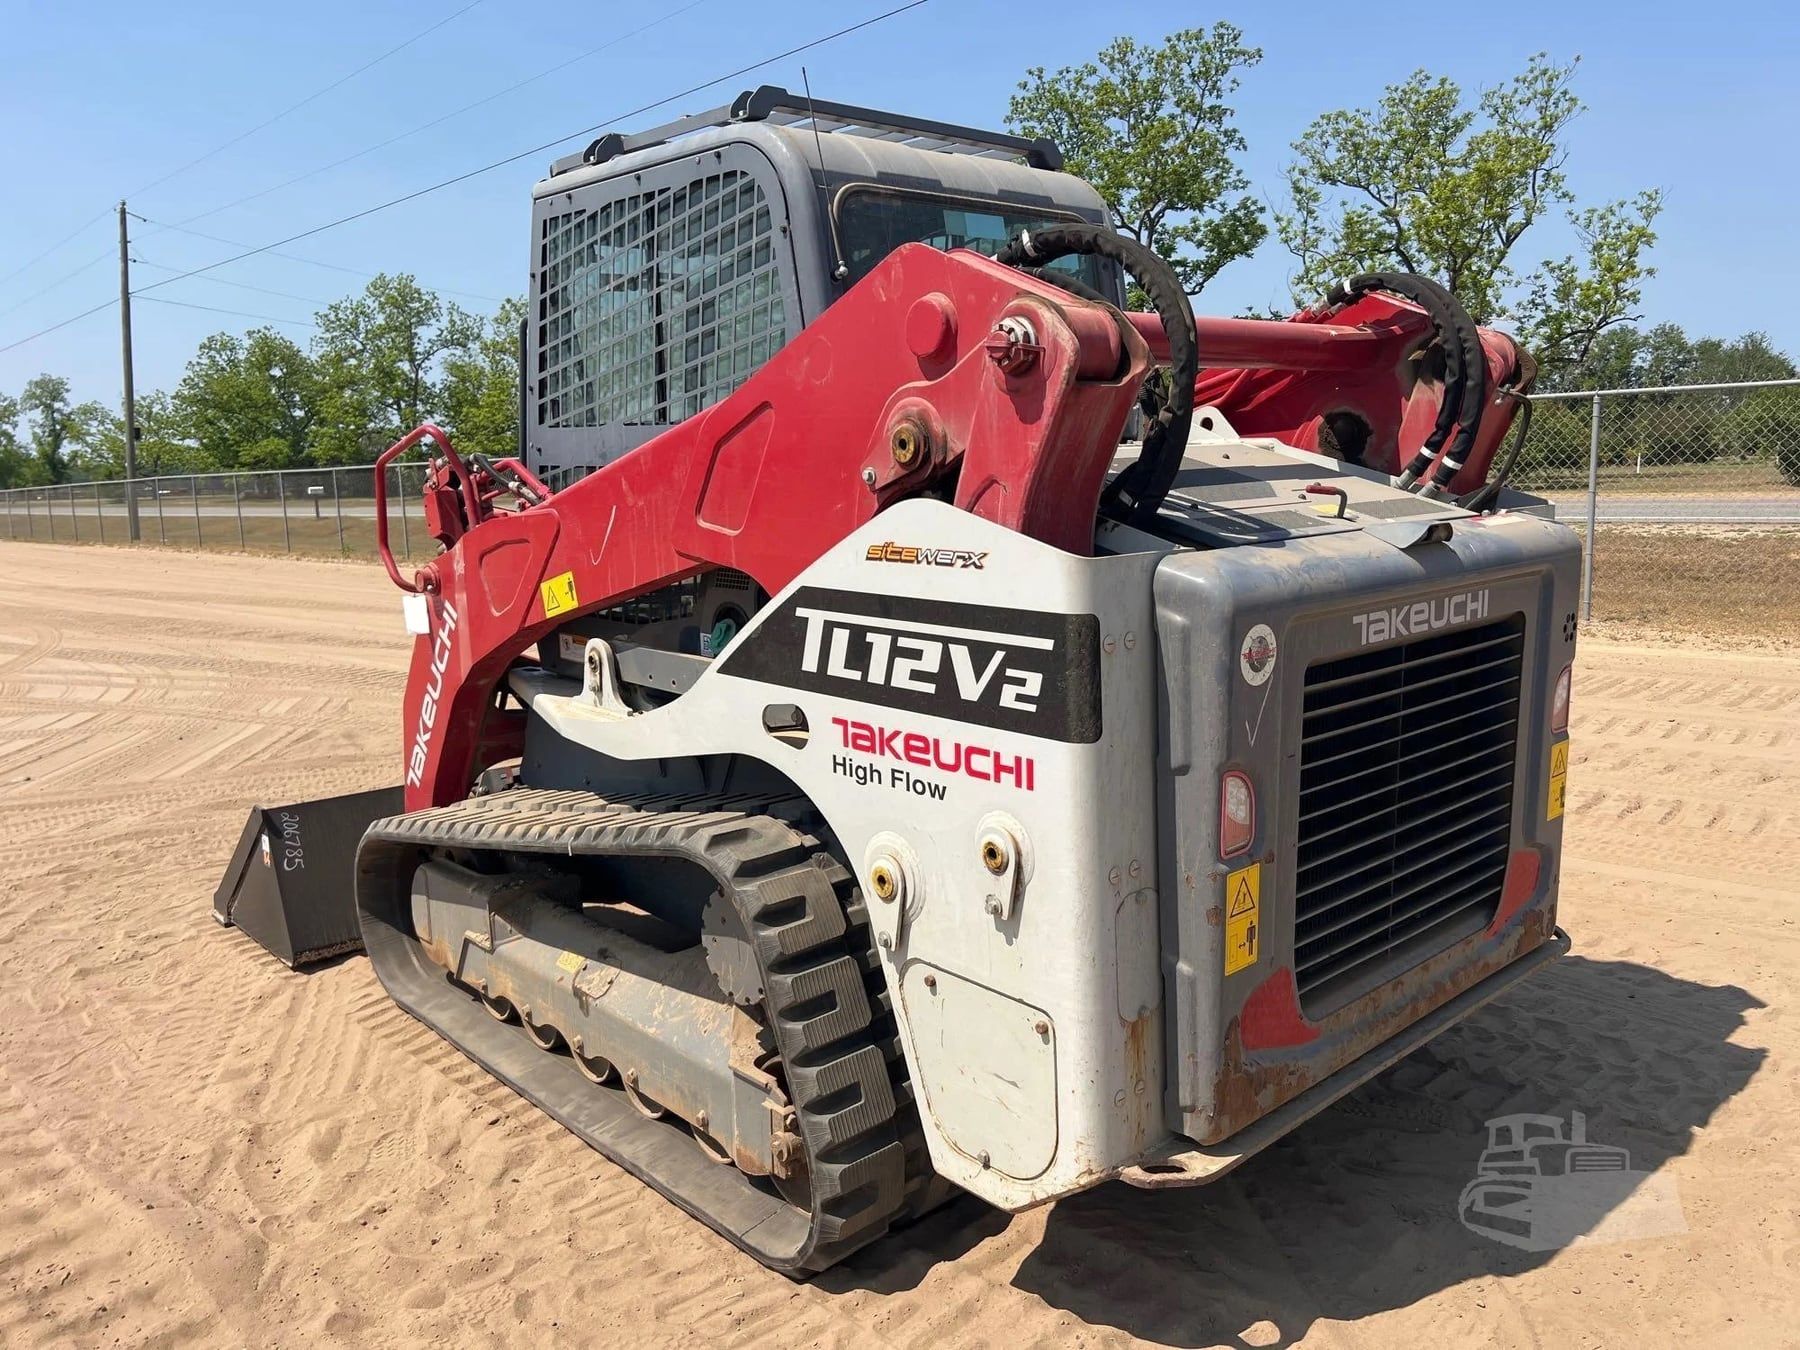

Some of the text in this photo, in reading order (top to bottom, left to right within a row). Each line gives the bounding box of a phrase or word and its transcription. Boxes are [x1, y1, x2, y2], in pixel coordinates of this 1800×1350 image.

[865, 541, 988, 569] sitewerx
[1352, 590, 1489, 646] TAKEUCHI
[795, 607, 1054, 712] TL12V2
[407, 600, 458, 788] TAKEUCHI
[832, 717, 1034, 791] TAKEUCHI
[832, 754, 947, 800] High Flow
[281, 812, 305, 871] 206785
